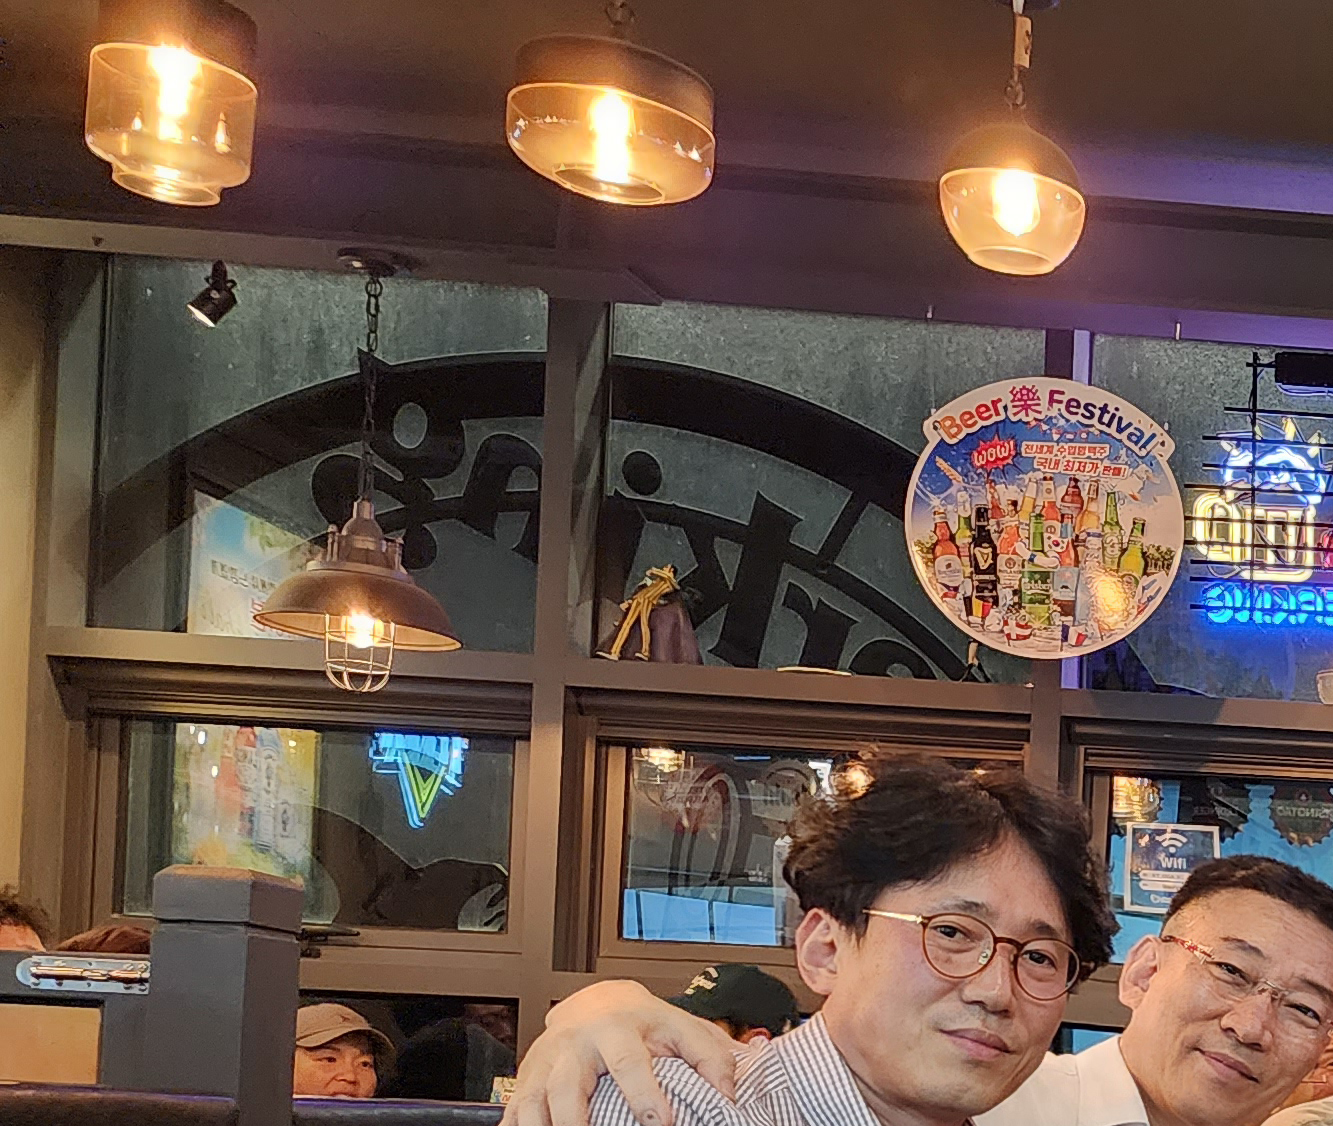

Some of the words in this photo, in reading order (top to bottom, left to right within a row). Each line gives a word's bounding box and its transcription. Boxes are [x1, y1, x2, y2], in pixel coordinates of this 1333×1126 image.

[940, 398, 1002, 440] Beer
[1009, 385, 1043, 418] 樂
[1047, 390, 1157, 451] Festival
[1036, 457, 1060, 471] 국내
[1063, 460, 1099, 474] 최저가
